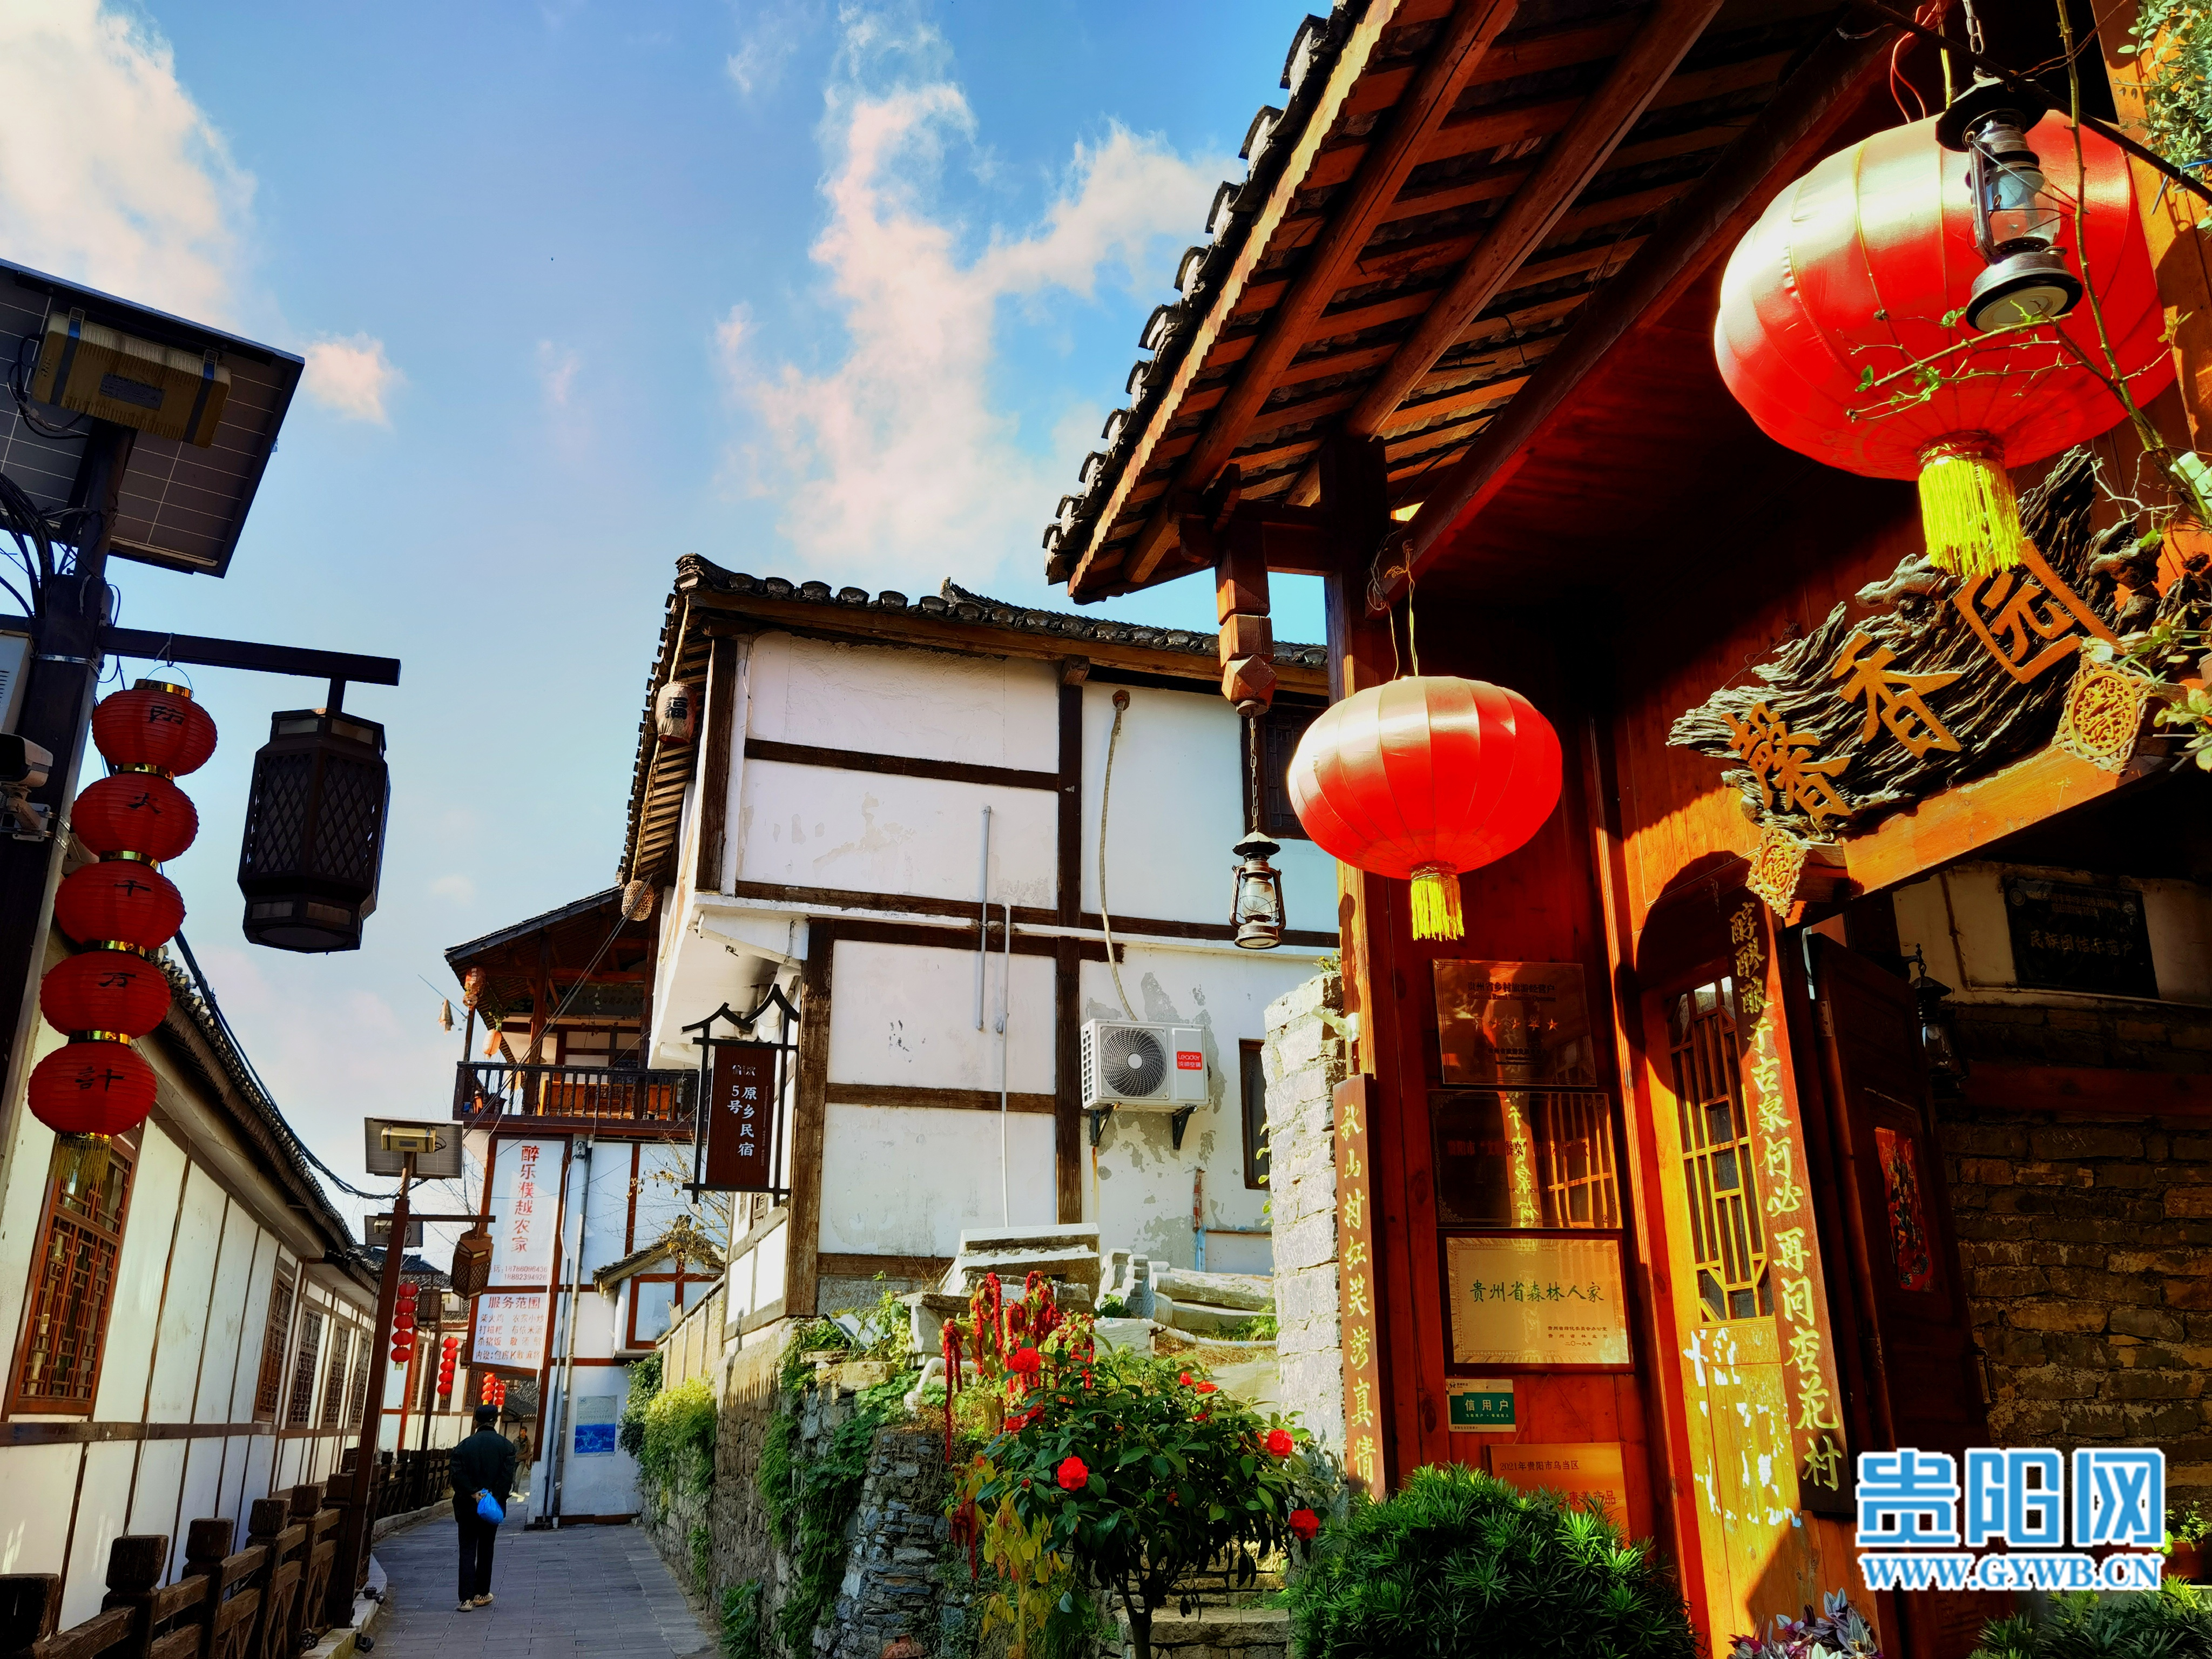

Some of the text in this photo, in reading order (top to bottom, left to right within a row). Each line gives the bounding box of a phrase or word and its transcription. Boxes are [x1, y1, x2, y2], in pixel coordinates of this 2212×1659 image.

[664, 696, 688, 720] 福
[727, 1085, 743, 1114] 5号
[737, 1087, 757, 1156] 原乡民宿
[511, 1145, 540, 1253] 醉乐濮越农家
[488, 1296, 541, 1309] 服务范围
[1470, 1279, 1604, 1303] 贵州省森林人家
[1465, 1399, 1508, 1411] 信用户
[1500, 1460, 1580, 1471] 2021年贵阳市乌当区
